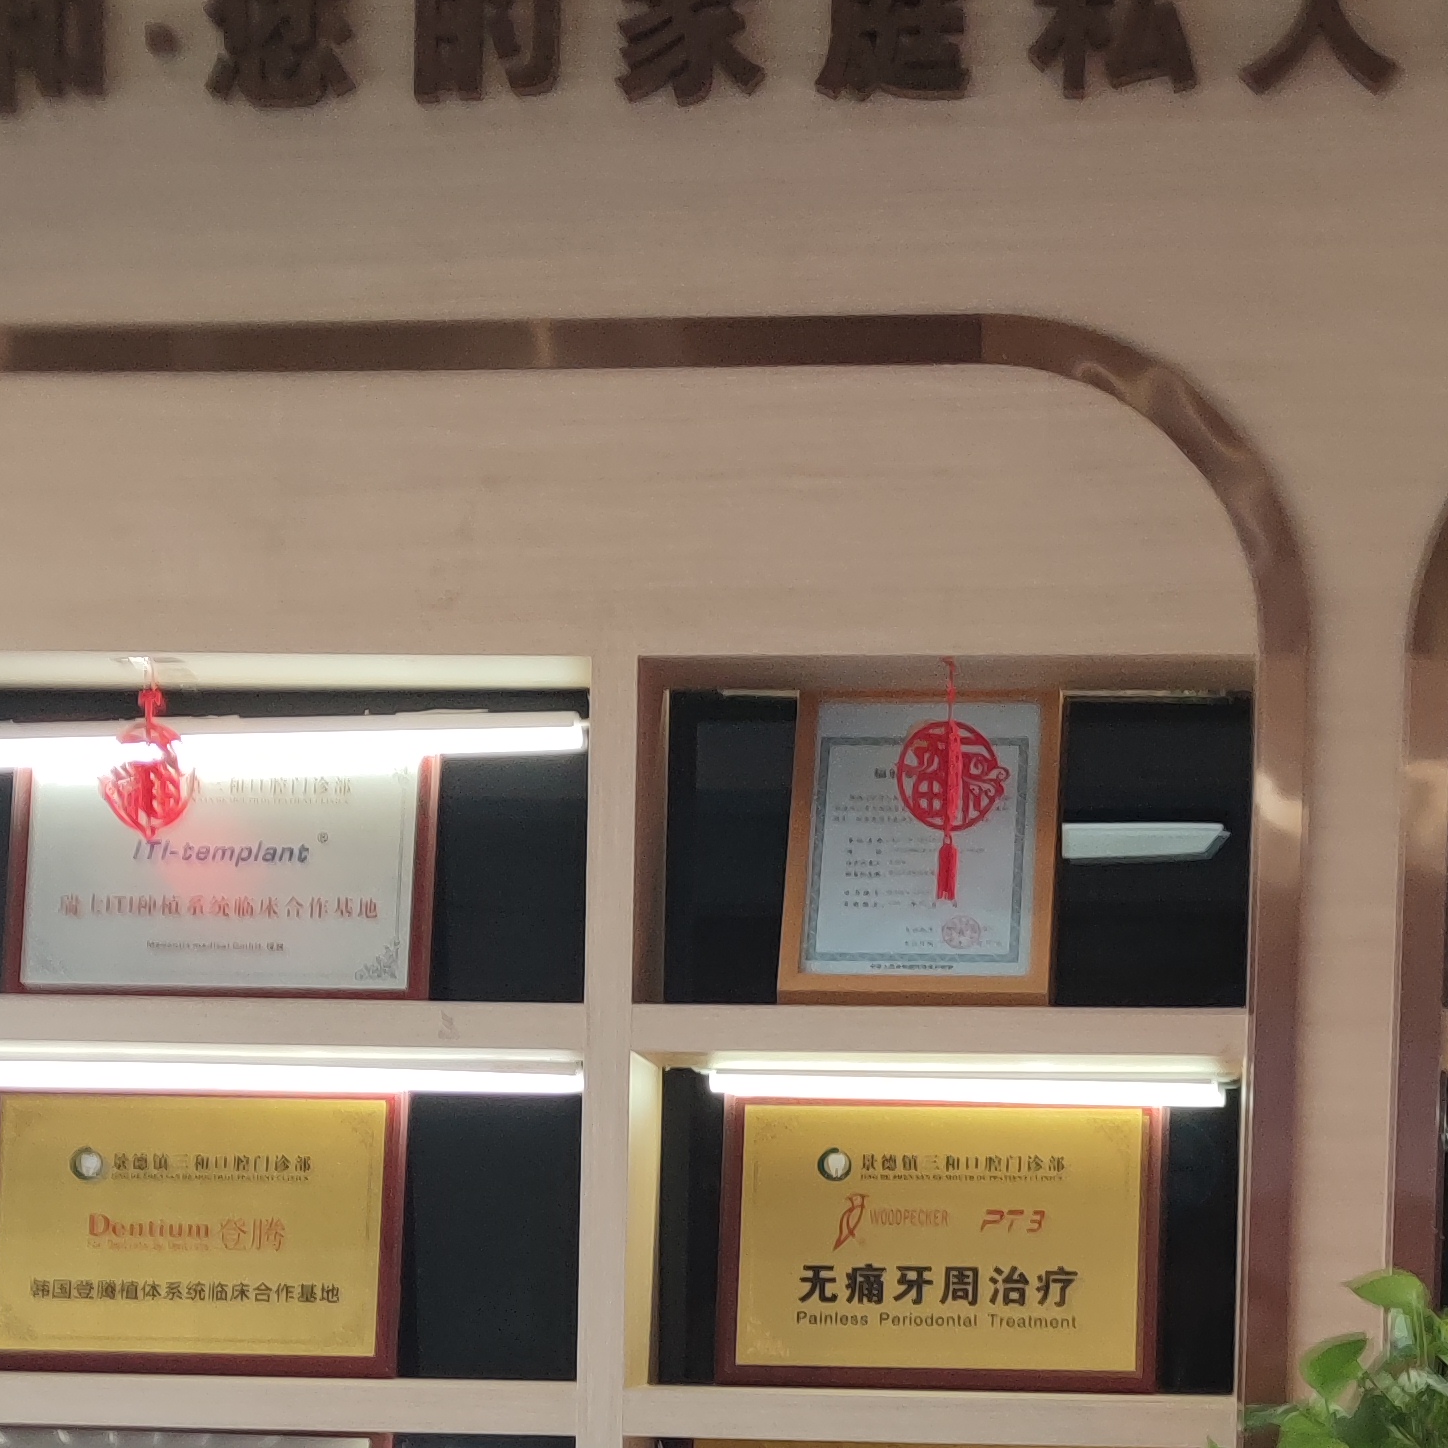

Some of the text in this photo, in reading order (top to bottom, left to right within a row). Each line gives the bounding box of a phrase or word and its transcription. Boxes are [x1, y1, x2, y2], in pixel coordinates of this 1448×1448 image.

[112, 1152, 312, 1172] 景德镇三和口腔门诊部
[861, 1153, 1065, 1173] 景德镇三和口腔门诊部
[869, 1208, 950, 1227] WOODPECKER
[88, 1212, 286, 1252] Dentium 登腾
[30, 1279, 340, 1303] 韩国登腾植体系统临床合作基地
[797, 1264, 1079, 1308] 无痛牙周治疗
[796, 1311, 1078, 1330] Painless Periodontal Treatment
